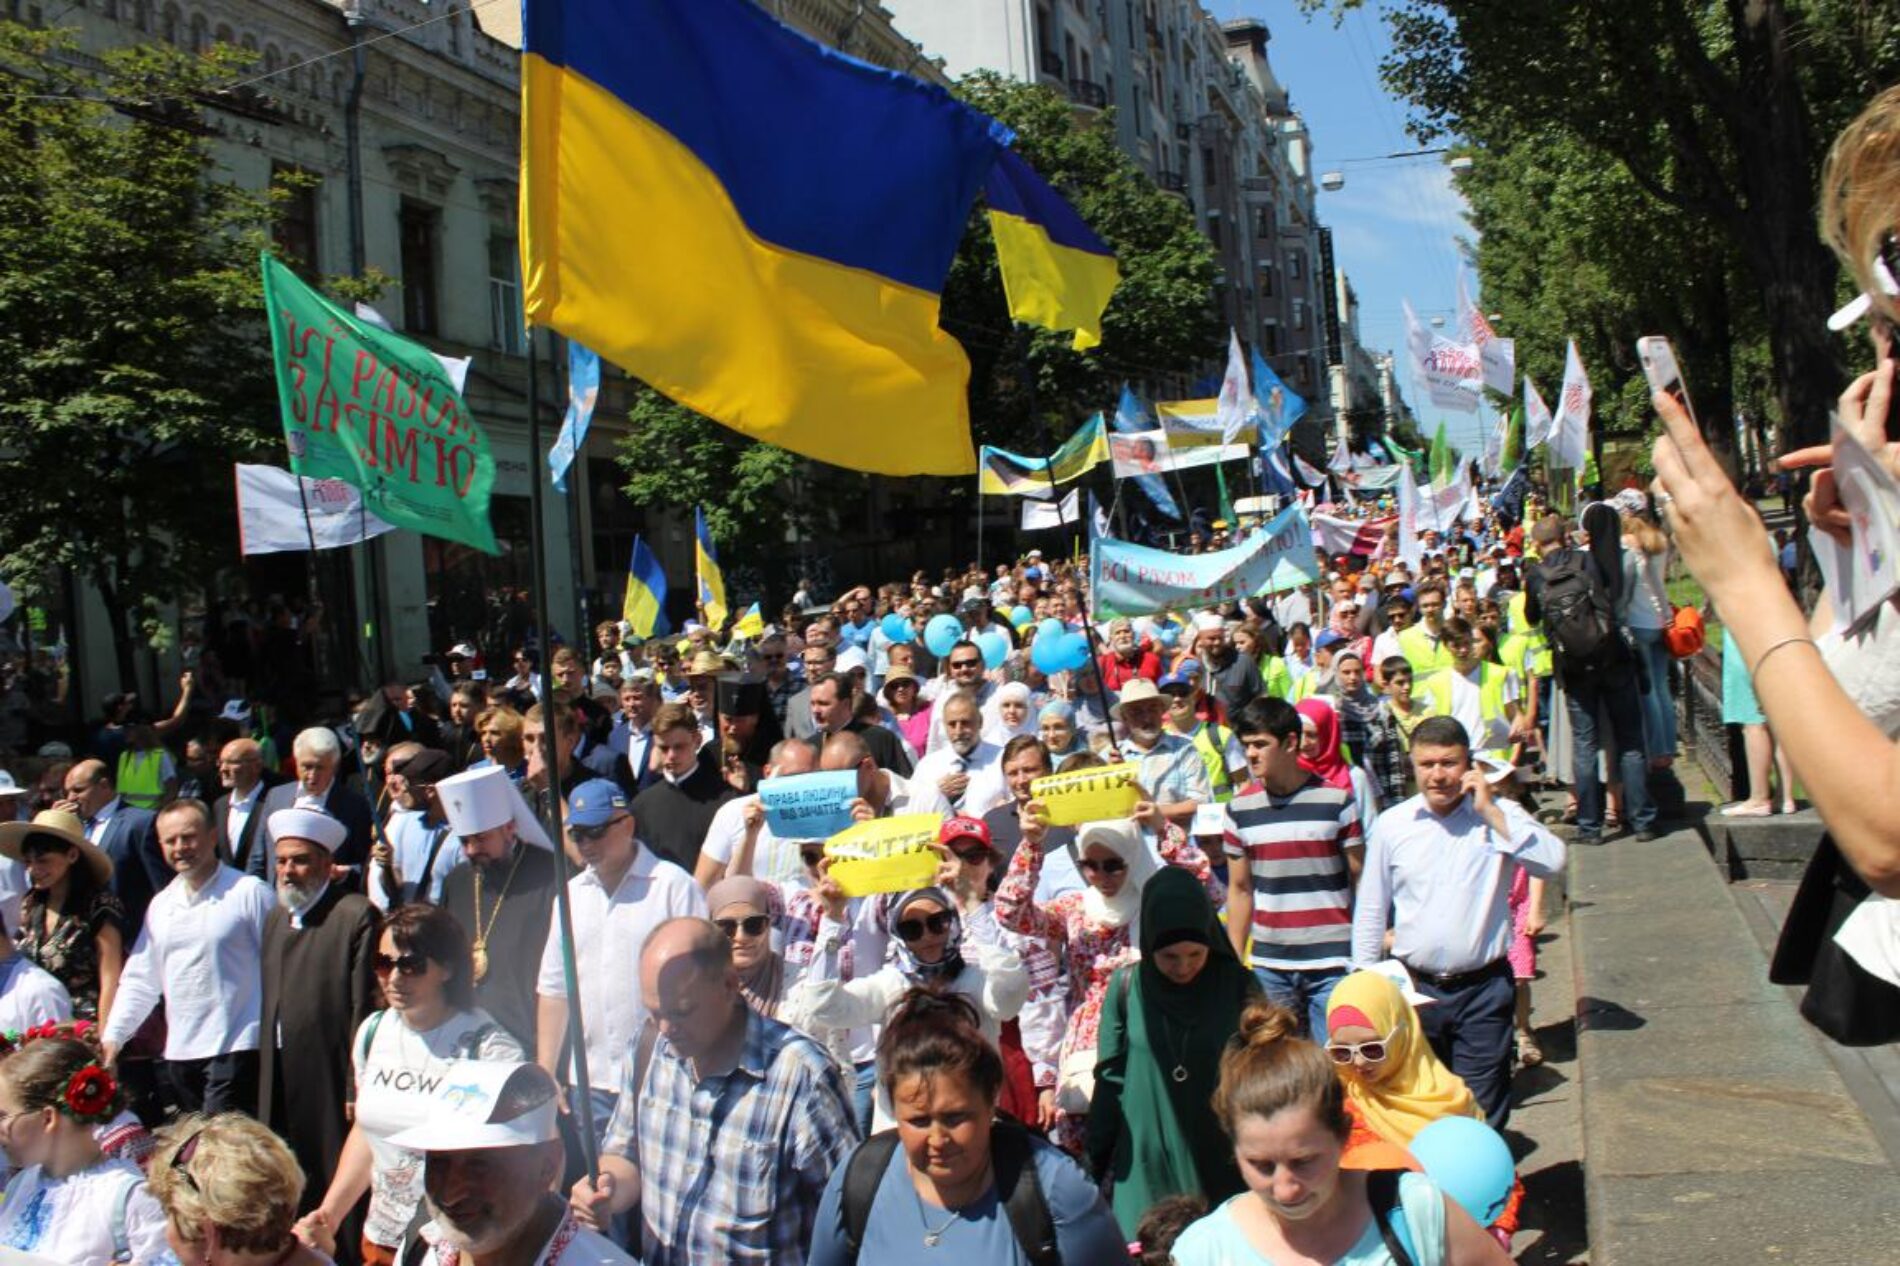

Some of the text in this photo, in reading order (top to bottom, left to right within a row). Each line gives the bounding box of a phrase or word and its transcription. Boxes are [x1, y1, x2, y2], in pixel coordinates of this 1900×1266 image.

[287, 361, 339, 434] ЗА
[768, 785, 849, 807] ПРАВА ЛЮДИНИ
[1038, 769, 1135, 797] ЖИТТЯ
[780, 805, 797, 821] ВІД
[373, 1069, 443, 1095] NOW
